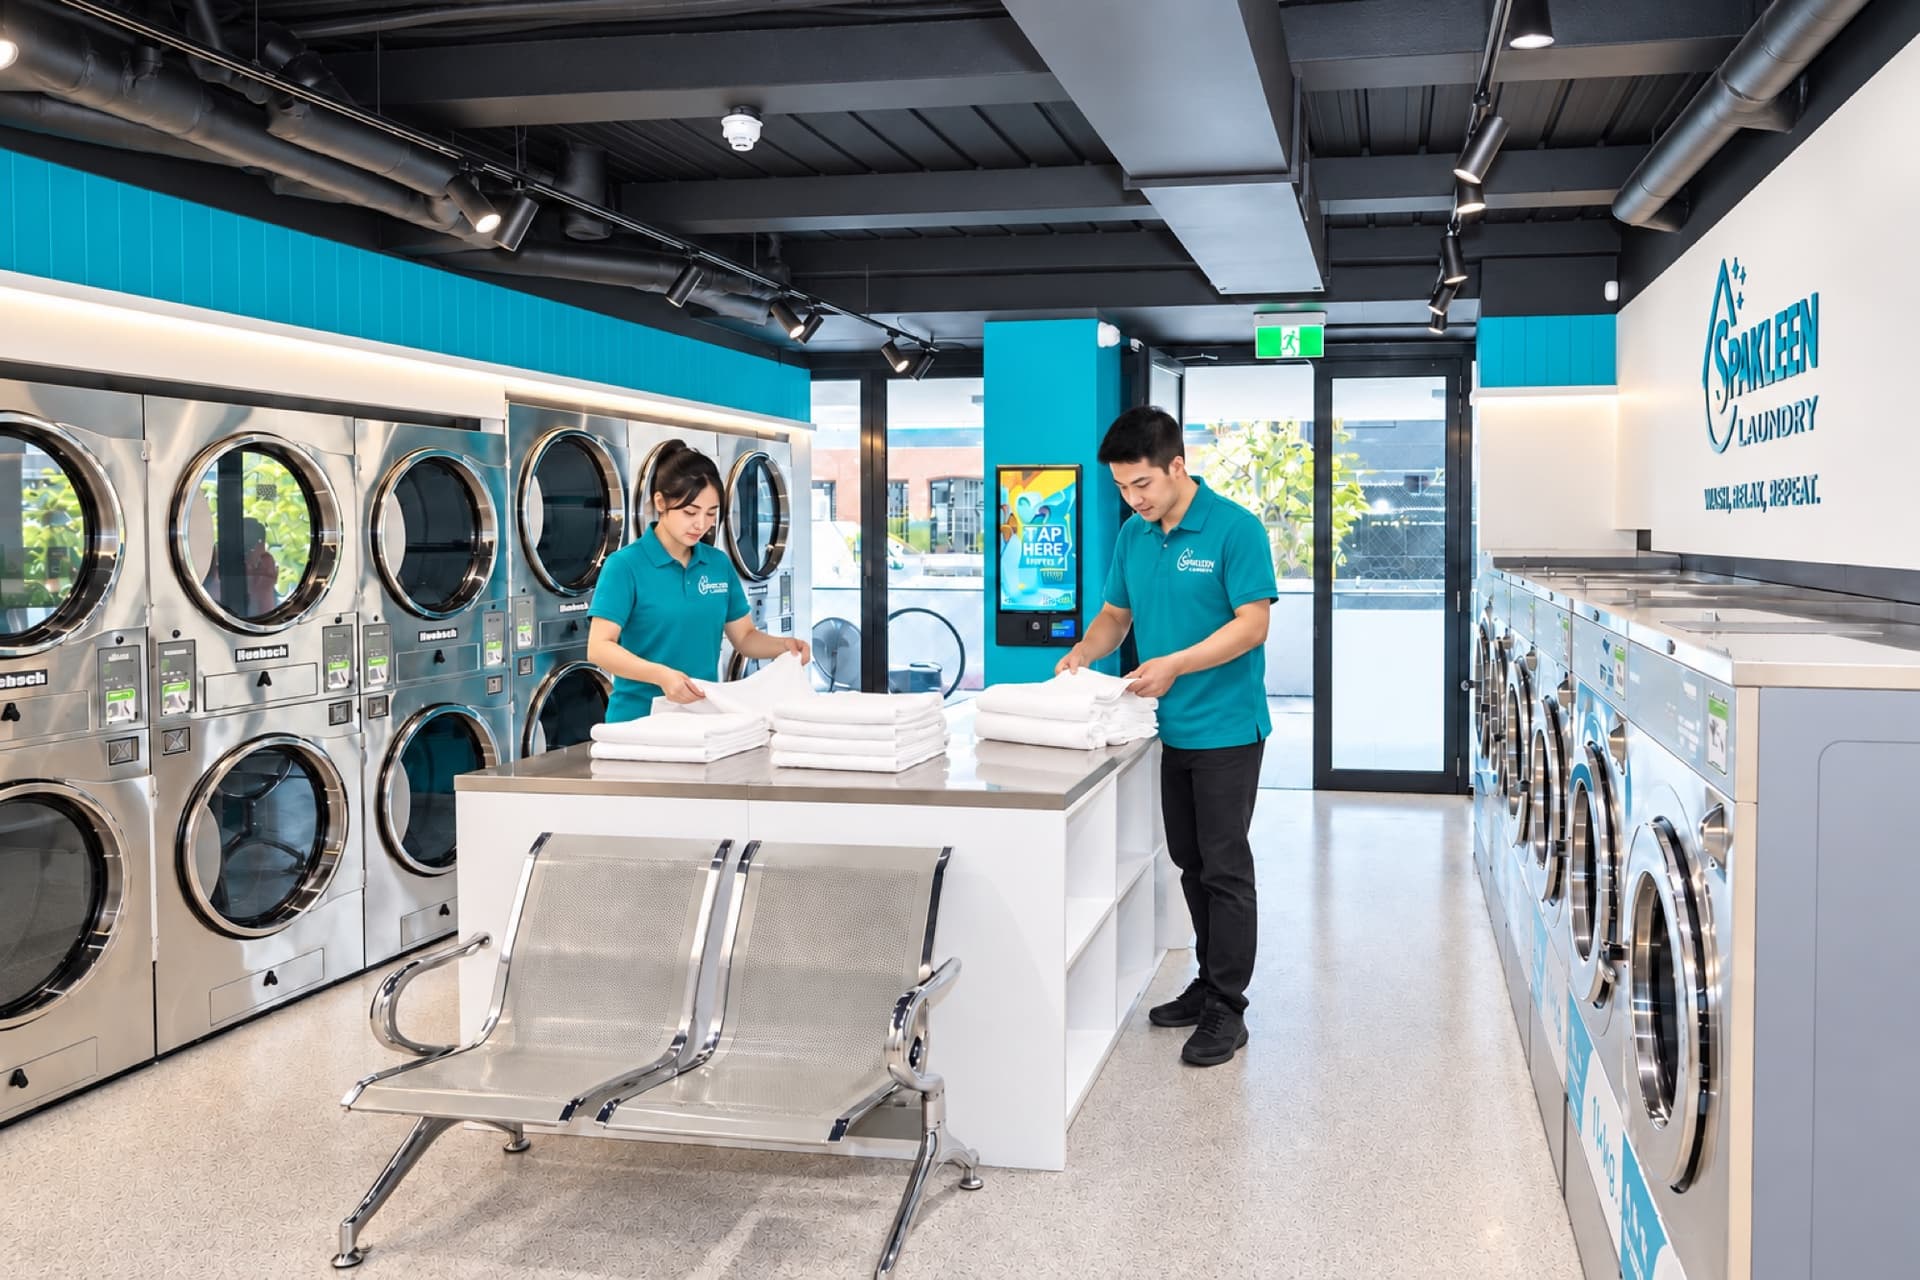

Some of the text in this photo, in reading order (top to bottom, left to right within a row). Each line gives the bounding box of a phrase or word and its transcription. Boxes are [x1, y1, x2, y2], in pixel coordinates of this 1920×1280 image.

[1713, 291, 1820, 415] SPAKLEEN
[1738, 395, 1820, 447] LAUNDRY
[1769, 473, 1822, 507] REPEAT.
[1023, 542, 1064, 557] HERE
[1024, 526, 1062, 542] TAP
